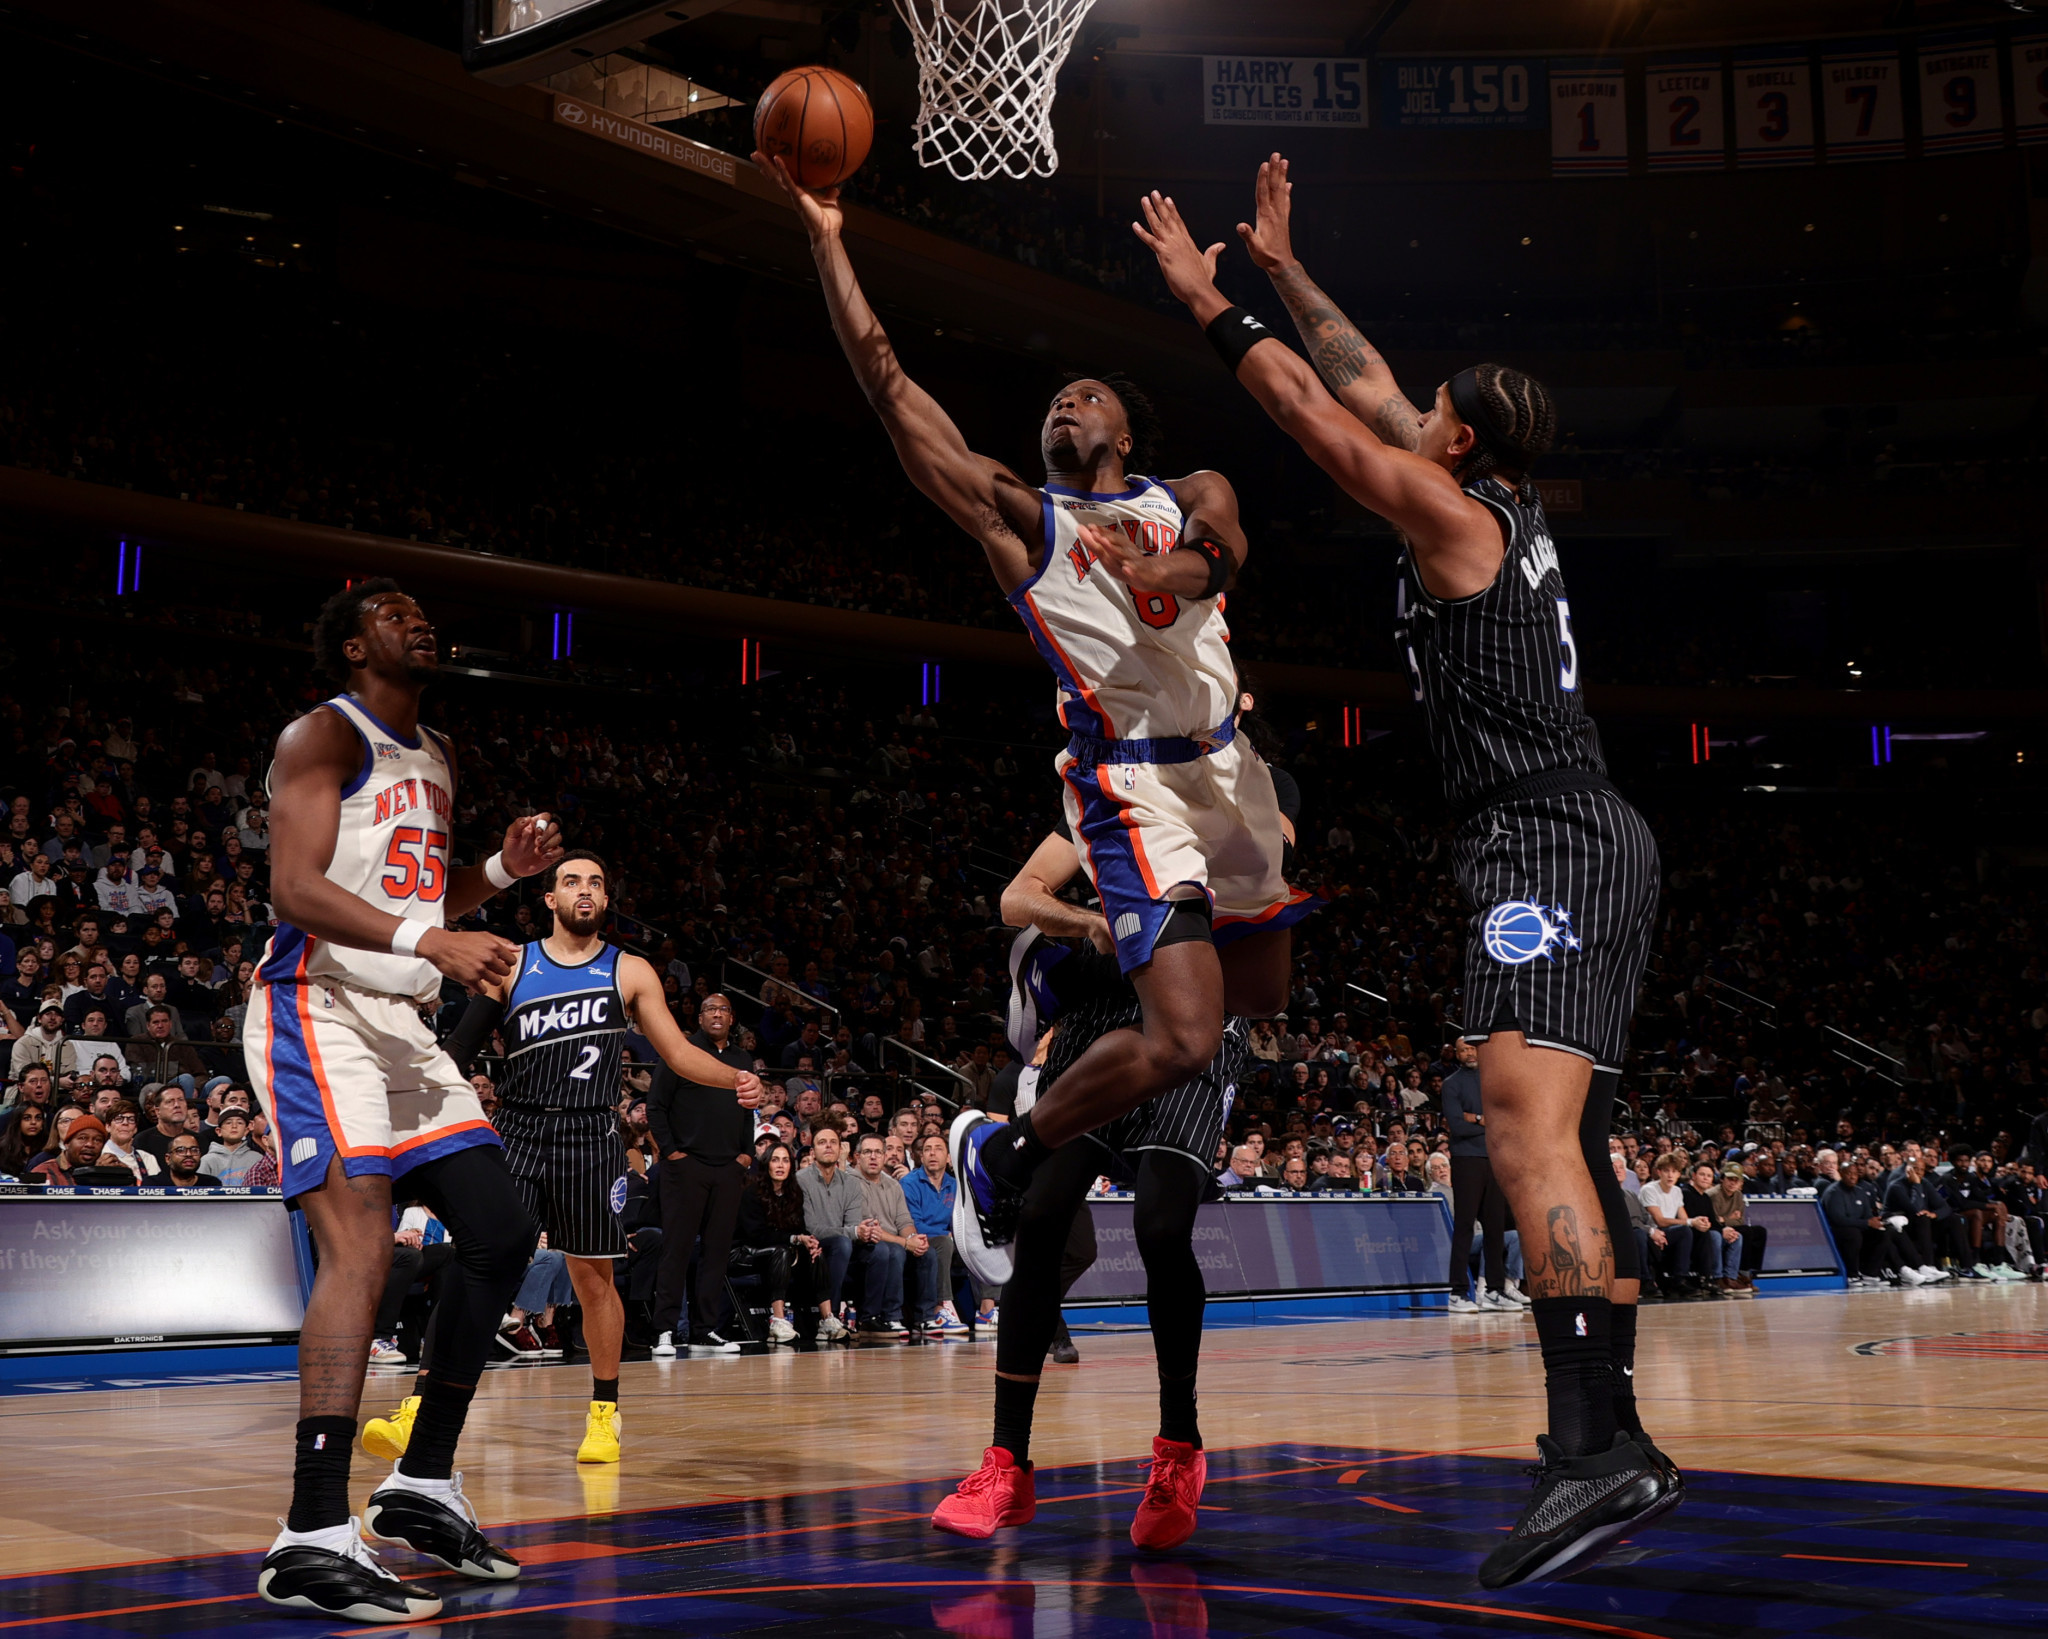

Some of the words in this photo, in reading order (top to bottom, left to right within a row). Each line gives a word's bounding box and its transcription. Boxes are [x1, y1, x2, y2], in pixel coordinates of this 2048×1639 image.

[1217, 60, 1293, 84] HARRY
[1398, 66, 1442, 89] BILLY
[1746, 71, 1796, 89] HOWELL
[1832, 66, 1889, 84] GILBERT
[1313, 62, 1360, 109] 15
[1449, 65, 1529, 113] 150
[1658, 76, 1710, 93] LEETCH
[1211, 84, 1302, 108] STYLES
[1401, 91, 1441, 113] JOEL
[1943, 76, 1977, 127] 9
[1223, 109, 1273, 120] CONSECUTIVE
[1275, 110, 1302, 121] NIGHTS
[1304, 111, 1314, 121] AT
[1316, 111, 1329, 122] THE
[1332, 112, 1361, 122] GARDEN
[1669, 96, 1701, 146] 2
[1757, 91, 1789, 142] 3
[1845, 85, 1878, 137] 7
[1577, 102, 1600, 151] 1
[592, 113, 671, 156] HYUNDAI
[673, 143, 734, 179] BRIDGE
[1543, 488, 1575, 503] VEL
[1155, 504, 1177, 515] dhabi
[1122, 519, 1184, 556] YOR
[1555, 597, 1578, 692] 5
[373, 779, 418, 826] NEW
[381, 826, 448, 903] 55
[587, 966, 612, 979] Disney
[568, 1044, 601, 1081] 2
[0, 1186, 28, 1195] CHASE
[46, 1186, 76, 1196] CHASE
[93, 1186, 122, 1197] CHASE
[138, 1187, 166, 1197] CHASE
[182, 1187, 209, 1197] CHASE
[226, 1186, 251, 1196] CHASE
[267, 1186, 282, 1196] CHA
[33, 1219, 76, 1240] Ask
[81, 1224, 128, 1245] your
[136, 1219, 207, 1240] doctor
[1192, 1226, 1230, 1244] ason,
[0, 1249, 16, 1270] if
[20, 1248, 102, 1273] they're
[1100, 1252, 1146, 1271] medic
[114, 1335, 164, 1344] DAKTRONICS
